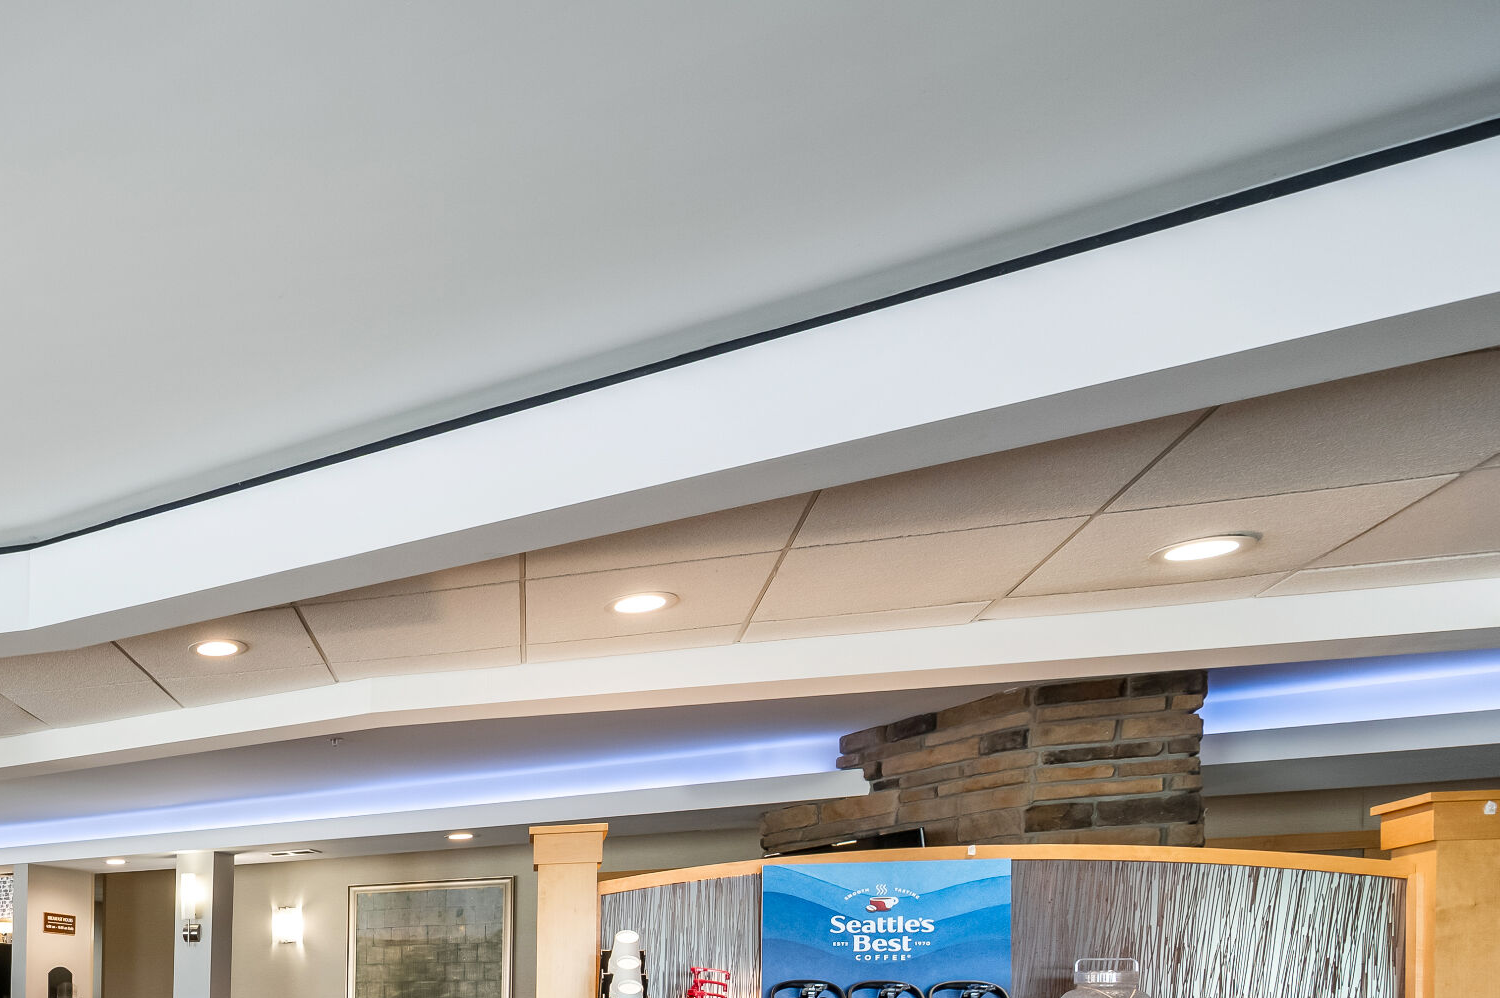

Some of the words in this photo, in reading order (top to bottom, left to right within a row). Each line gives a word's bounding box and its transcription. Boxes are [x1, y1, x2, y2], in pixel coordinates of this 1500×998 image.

[844, 888, 869, 900] SMOOTH
[830, 915, 935, 933] Seattle's
[853, 935, 912, 952] Best
